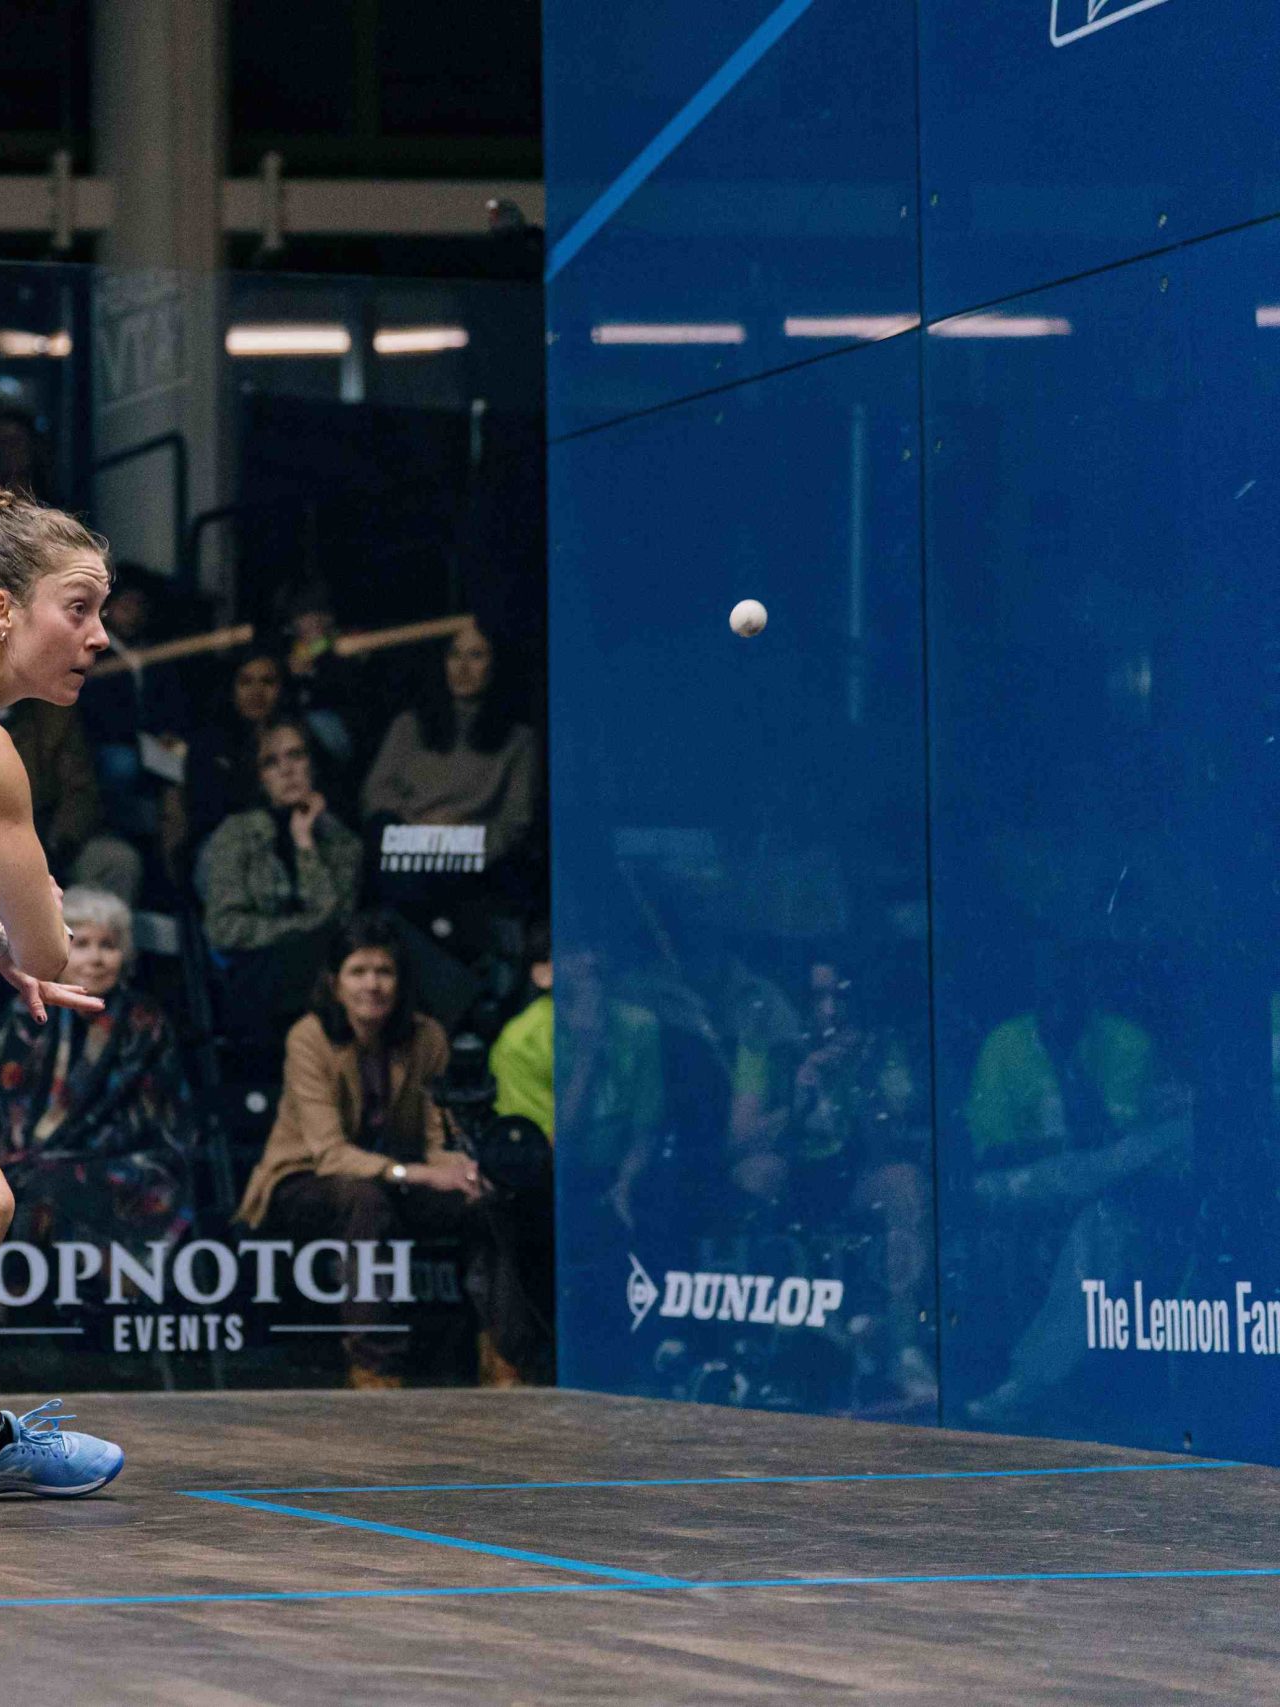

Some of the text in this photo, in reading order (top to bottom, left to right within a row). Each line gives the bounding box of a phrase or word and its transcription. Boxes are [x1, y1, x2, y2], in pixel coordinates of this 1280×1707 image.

[659, 1270, 844, 1328] DUNLOP
[1081, 1279, 1129, 1350] The
[1134, 1280, 1230, 1353] Lennon
[113, 1314, 244, 1352] EVENTS
